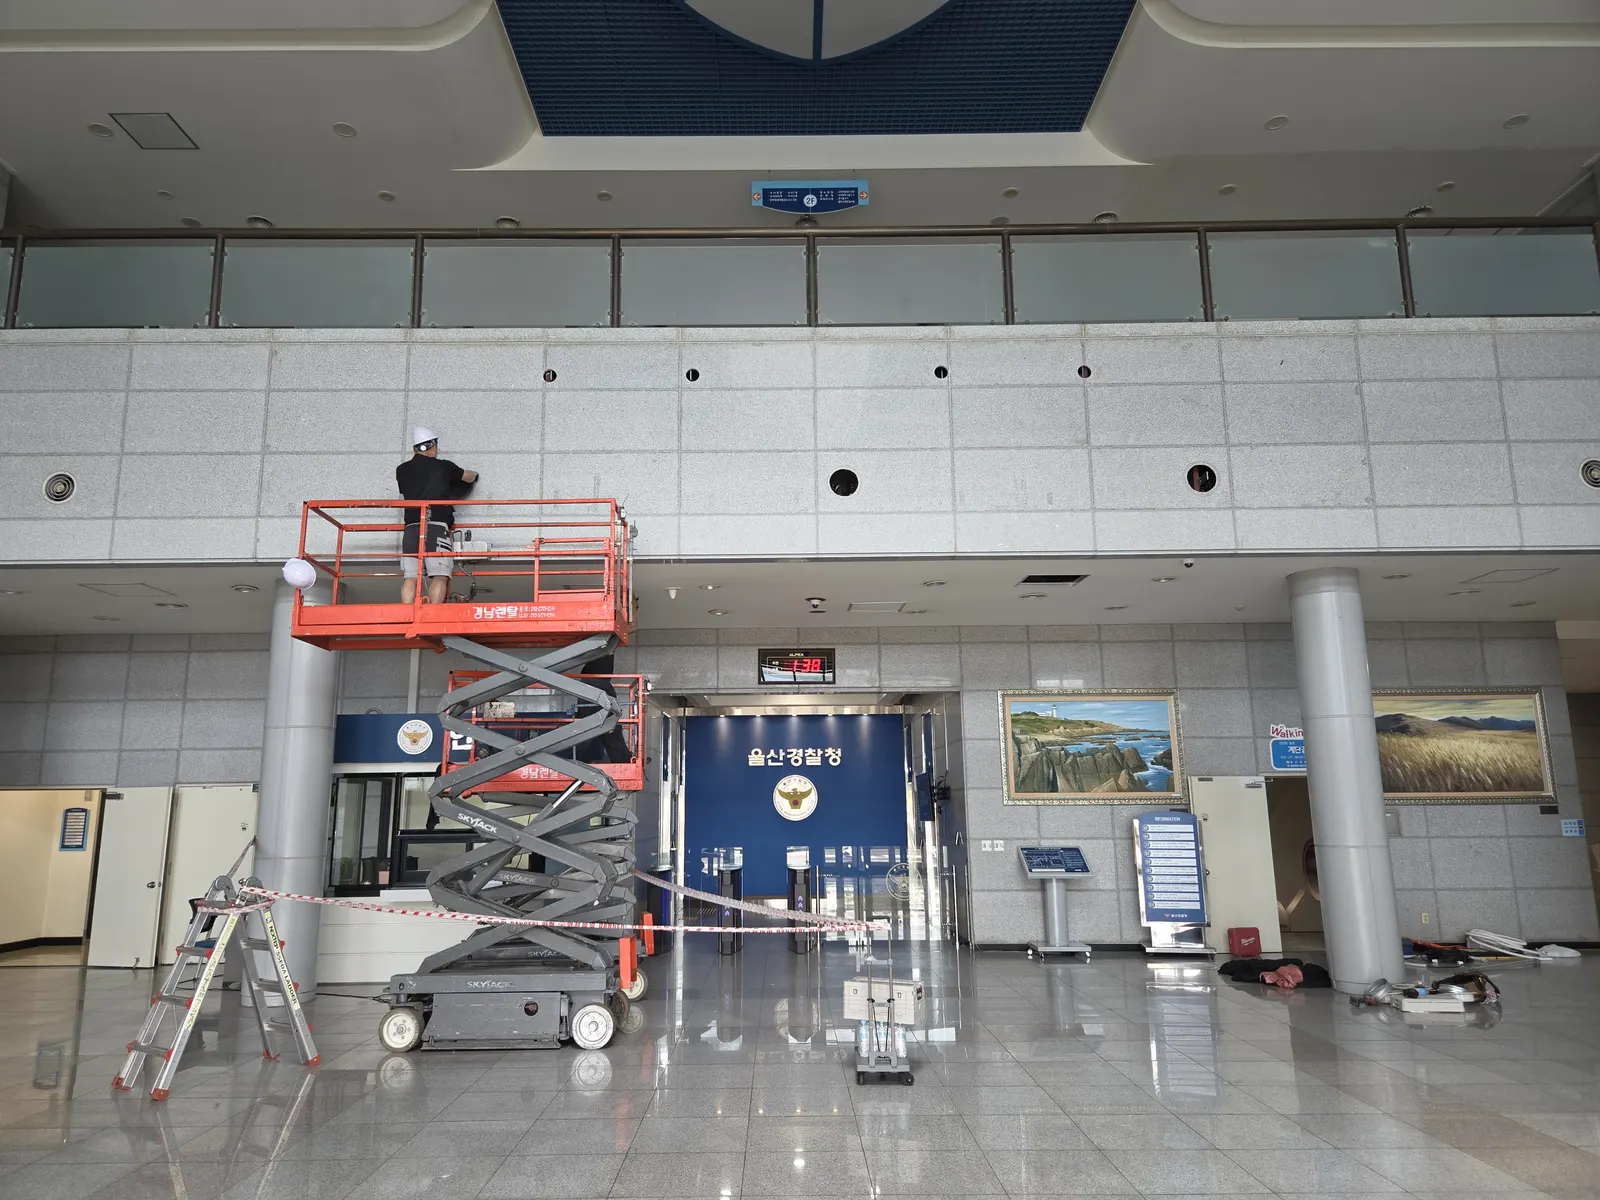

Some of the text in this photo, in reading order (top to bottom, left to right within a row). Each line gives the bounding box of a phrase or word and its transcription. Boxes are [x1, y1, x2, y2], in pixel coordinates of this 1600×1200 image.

[806, 197, 815, 205] 2F
[472, 606, 518, 619] 경남렌탈
[747, 748, 842, 767] 울산경찰청
[457, 812, 498, 834] SKYJACK
[498, 873, 536, 884] SKYJACK
[527, 948, 561, 958] SKYJAC
[285, 975, 298, 1005] LADDER
[466, 979, 515, 989] SKYJACK
